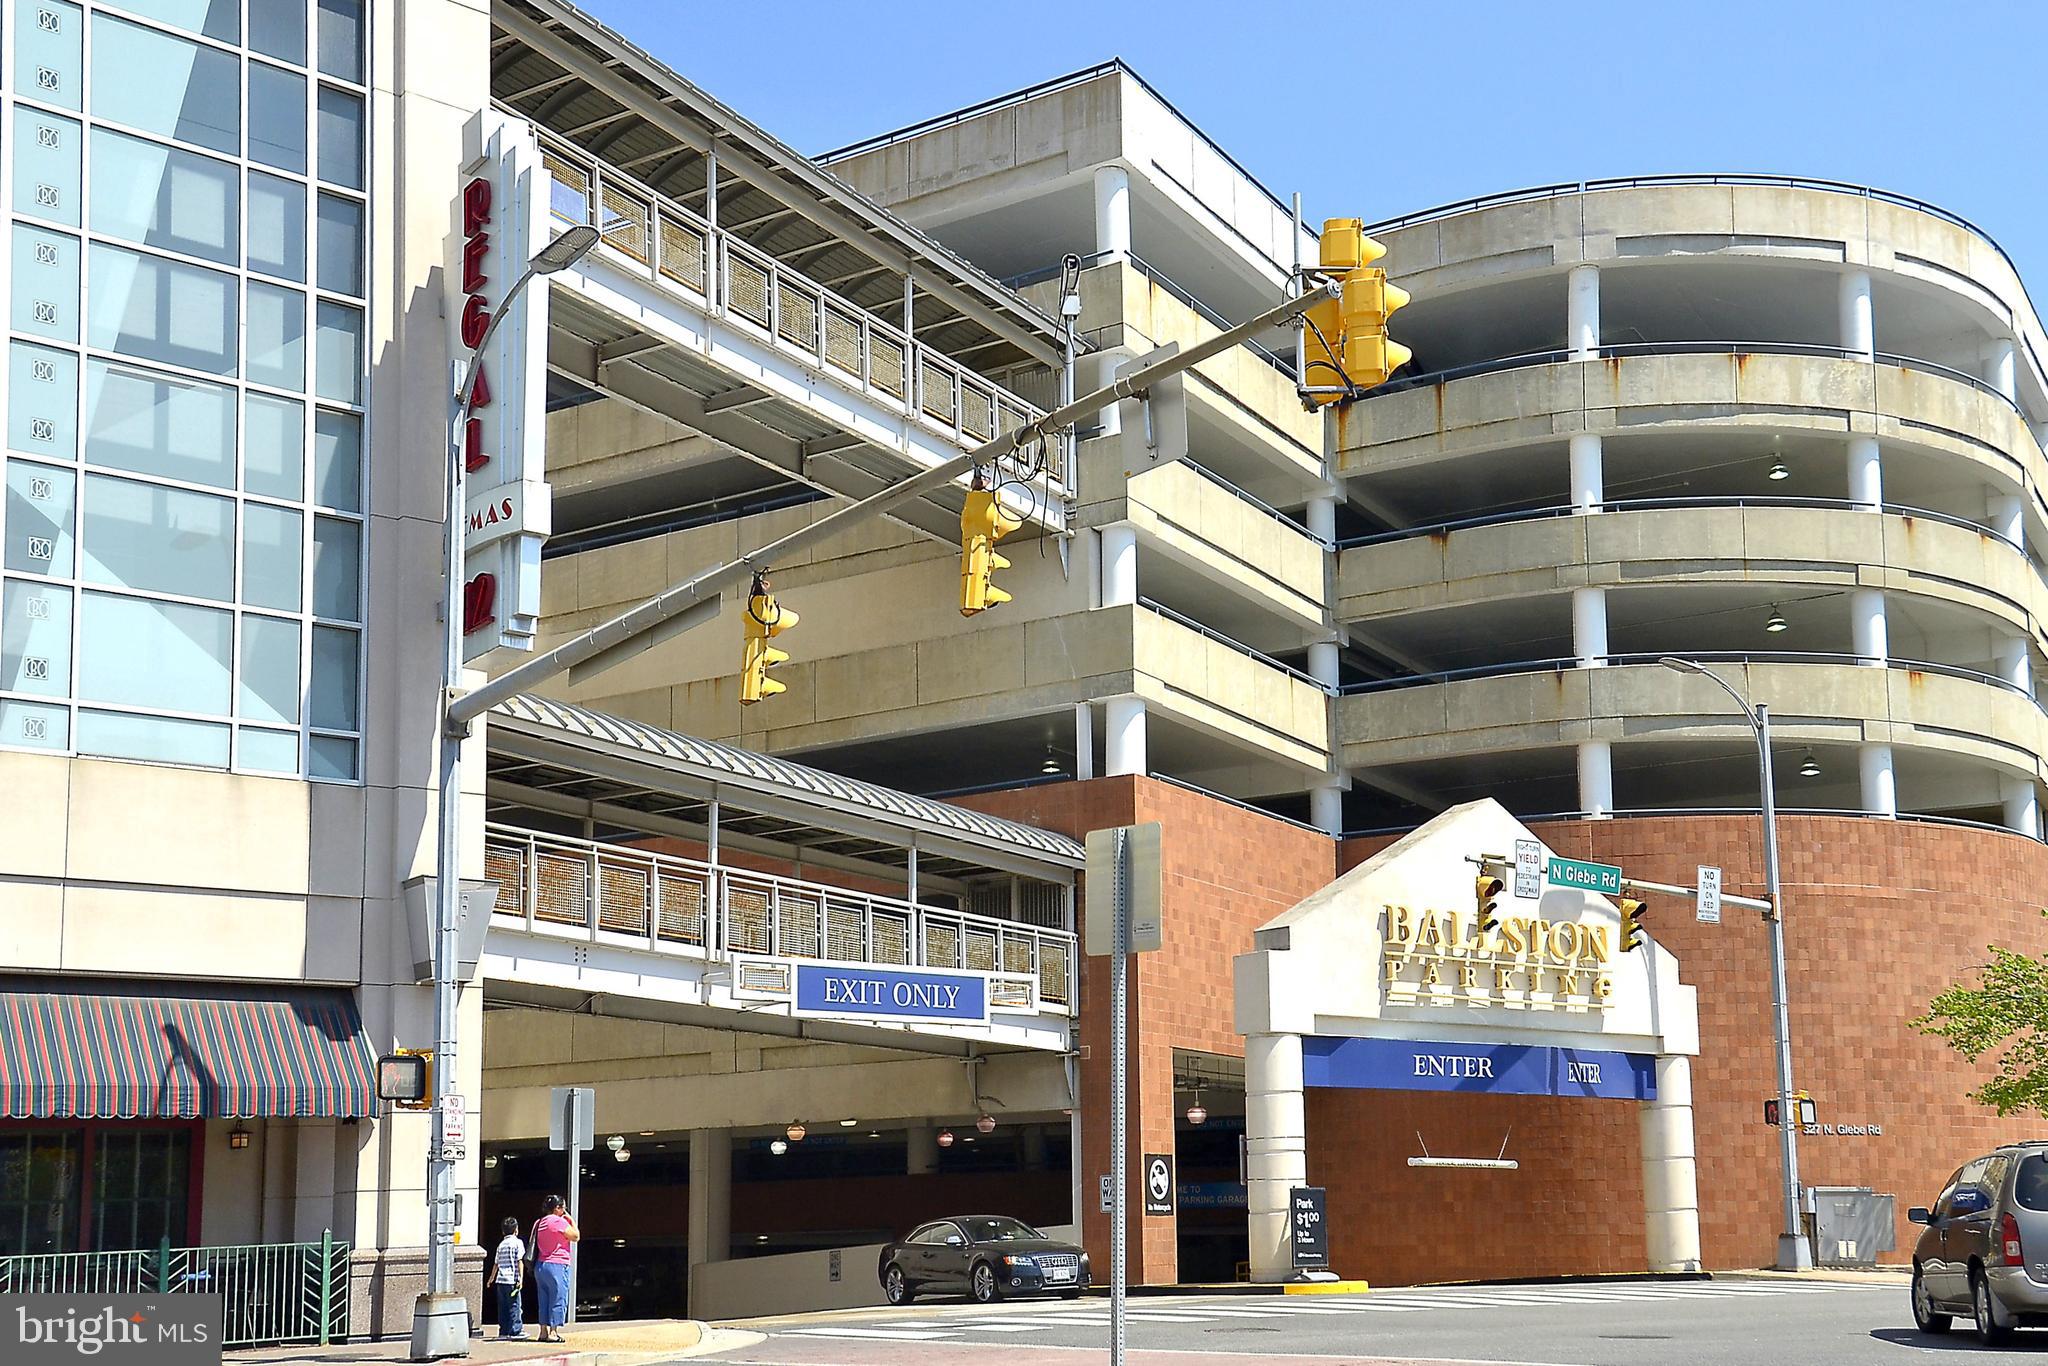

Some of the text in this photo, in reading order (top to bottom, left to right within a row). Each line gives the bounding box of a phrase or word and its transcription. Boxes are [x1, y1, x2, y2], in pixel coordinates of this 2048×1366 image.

[461, 177, 492, 473] REGAL
[1519, 853, 1539, 864] YIELD
[1553, 864, 1617, 888] N Glebe Rd
[1704, 870, 1715, 880] NO
[1702, 881, 1716, 890] TURN
[1705, 891, 1713, 899] ON
[1703, 900, 1714, 909] RED
[1383, 904, 1610, 963] BALLSTON
[1385, 959, 1614, 998] PARKING
[824, 977, 961, 1009] EXIT ONLY
[1413, 1054, 1494, 1078] ENTER
[1568, 1062, 1602, 1084] ENTER
[450, 1097, 459, 1108] NO
[1823, 1124, 1835, 1135] N.
[1837, 1124, 1866, 1135] Glebe
[1867, 1124, 1882, 1135] Rd
[1296, 1198, 1314, 1209] Park
